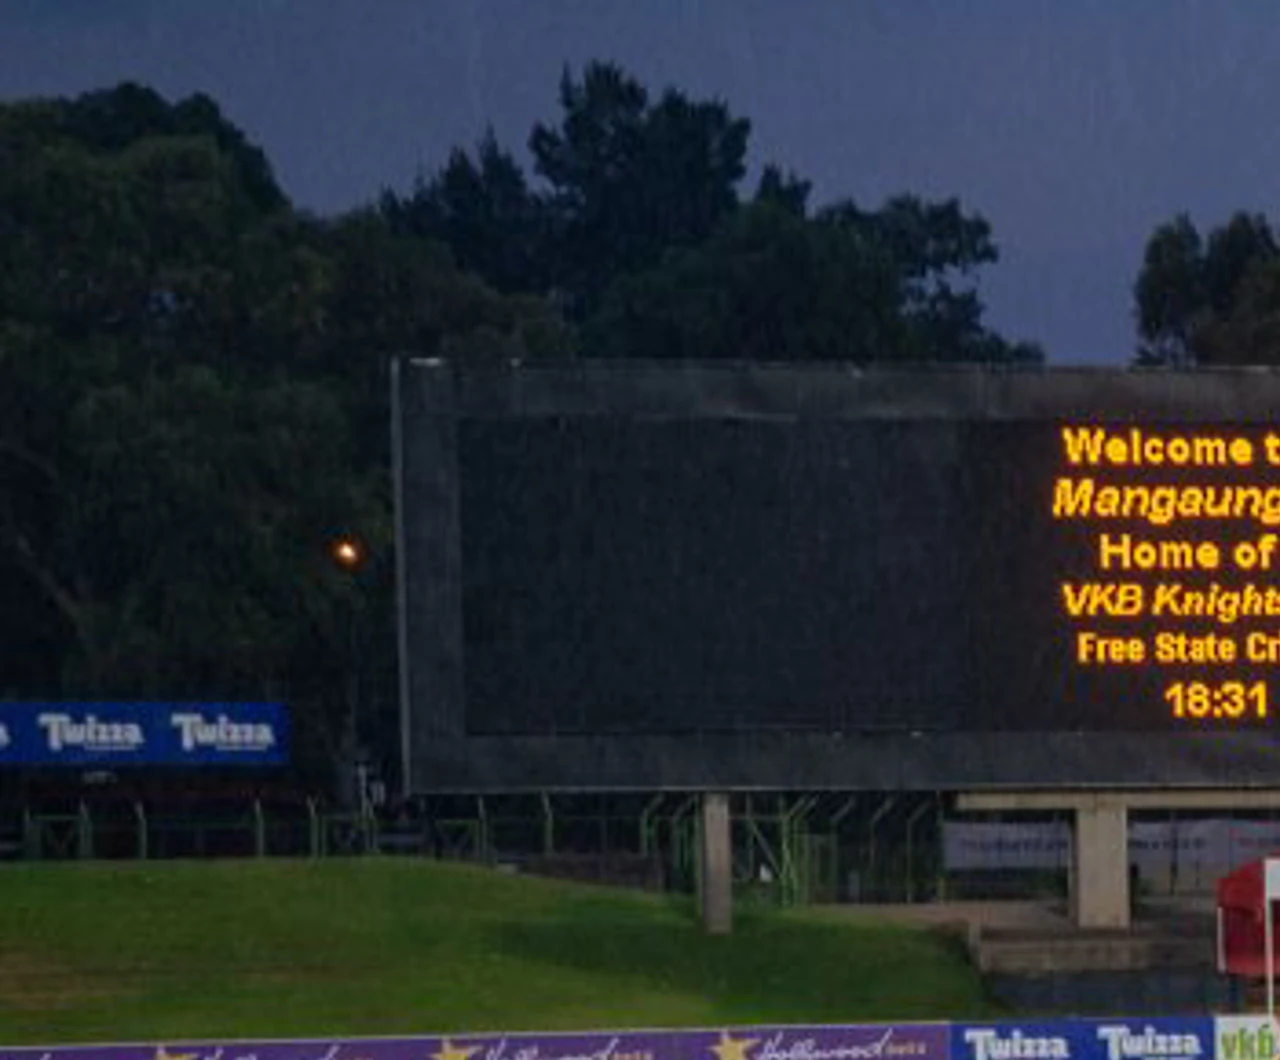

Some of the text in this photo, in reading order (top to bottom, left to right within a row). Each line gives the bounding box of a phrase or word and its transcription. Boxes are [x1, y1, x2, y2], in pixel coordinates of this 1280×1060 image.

[1061, 427, 1253, 465] Welcome
[1099, 532, 1220, 570] Home
[1233, 532, 1278, 570] of
[1061, 583, 1144, 617] VKB
[1076, 631, 1146, 664] Free
[1155, 631, 1237, 664] State
[1164, 680, 1268, 718] 18:31
